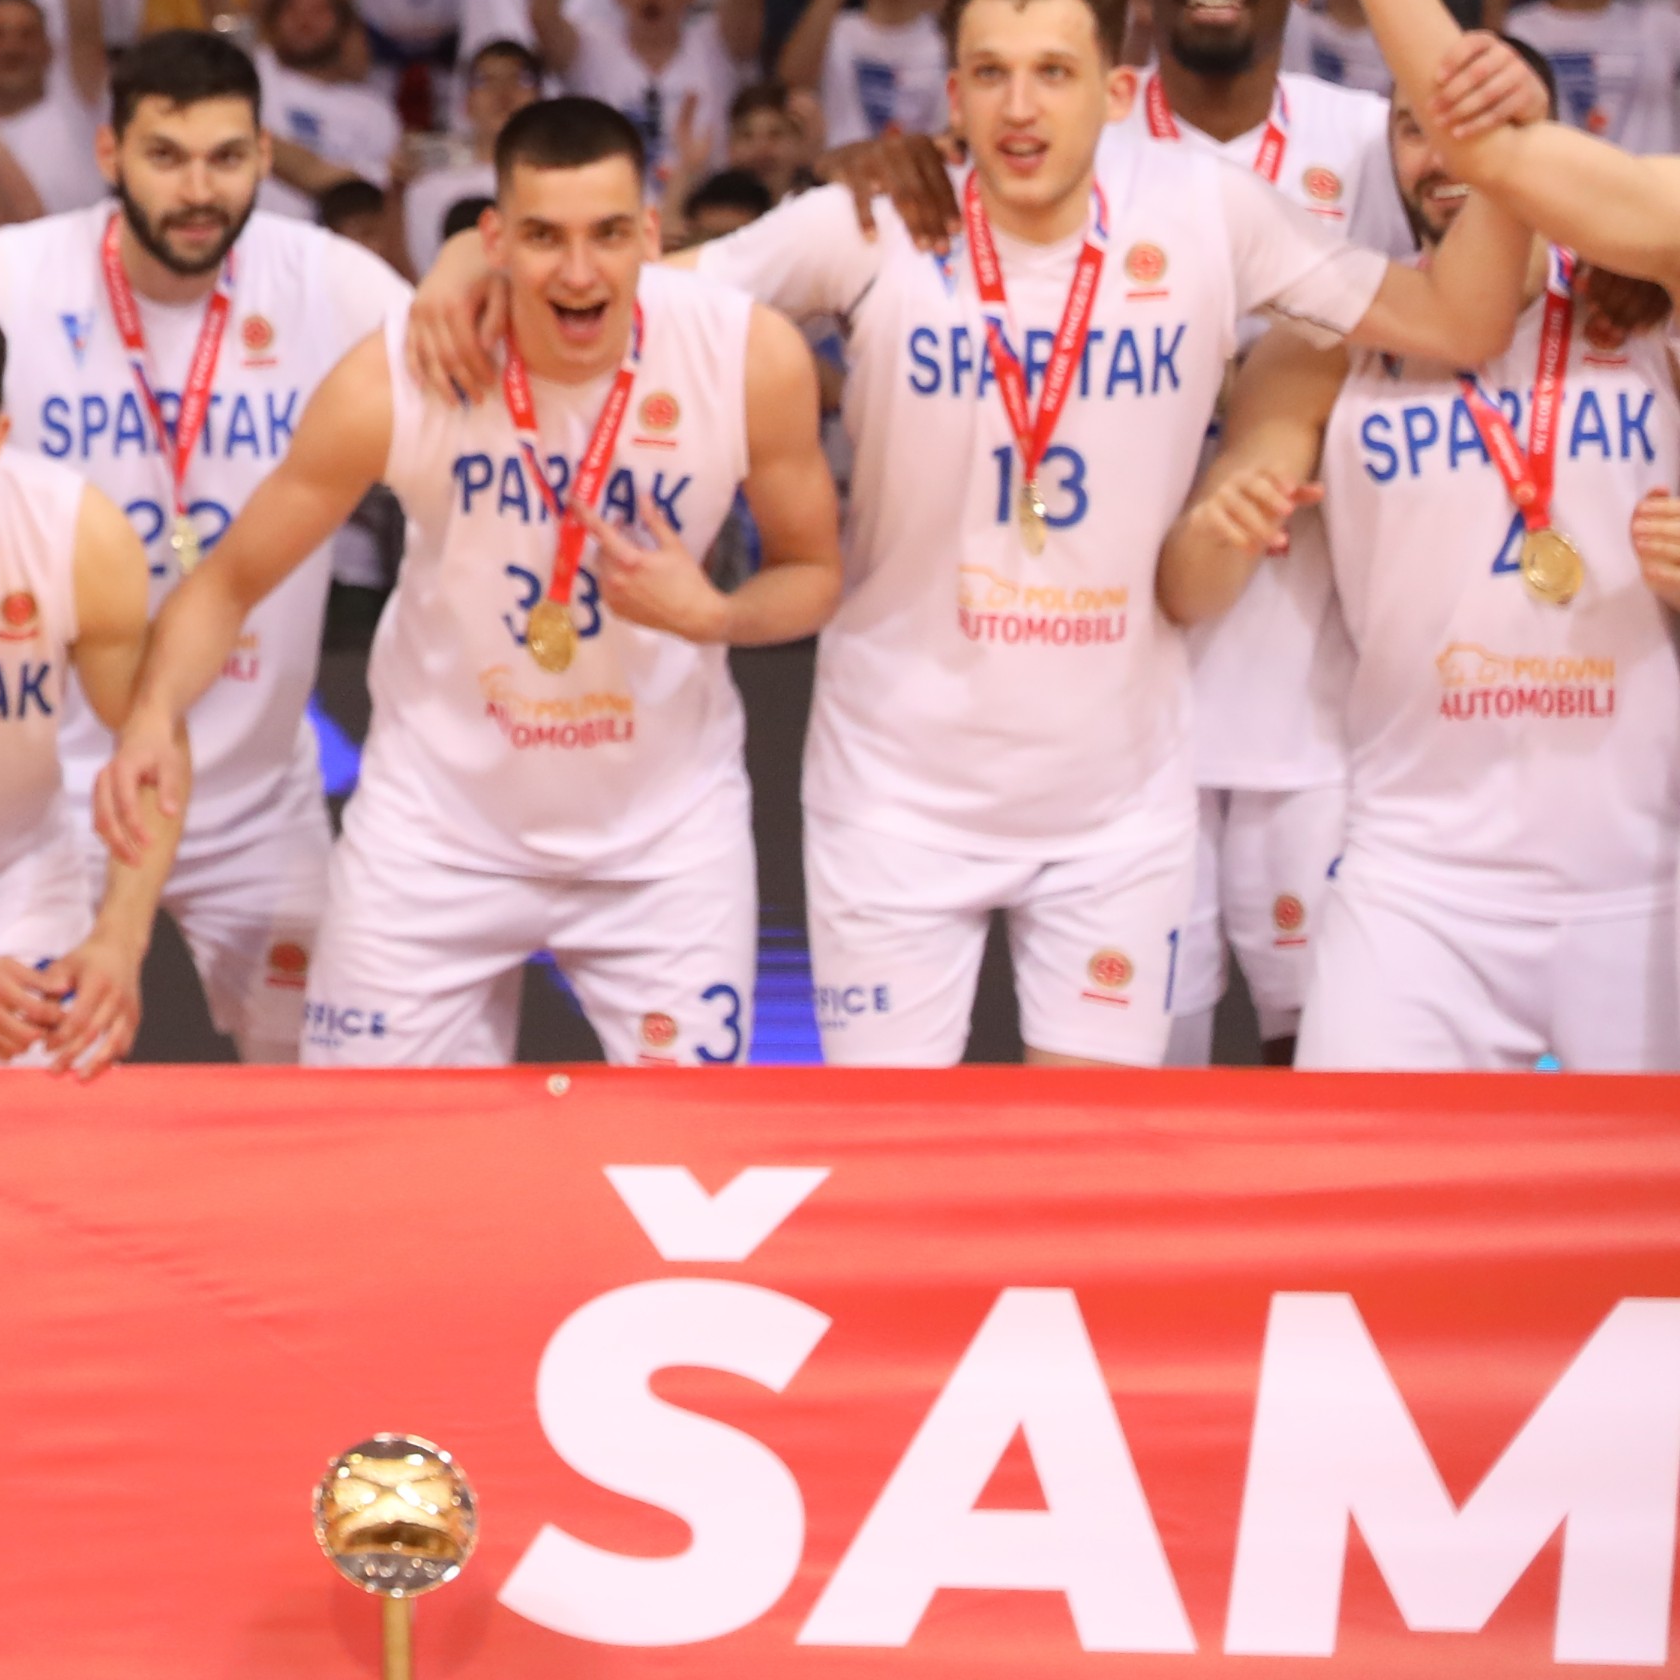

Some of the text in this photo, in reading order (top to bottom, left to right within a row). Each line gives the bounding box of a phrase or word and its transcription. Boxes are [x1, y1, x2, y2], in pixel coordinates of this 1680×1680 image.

[1361, 387, 1656, 485] SPARAK
[452, 452, 693, 533] PARAK
[992, 443, 1089, 528] 13
[502, 564, 603, 647] 33
[1440, 687, 1615, 721] AUTOMOBILI
[814, 984, 890, 1014] FICE
[495, 1164, 1680, 1666] ŠAM
